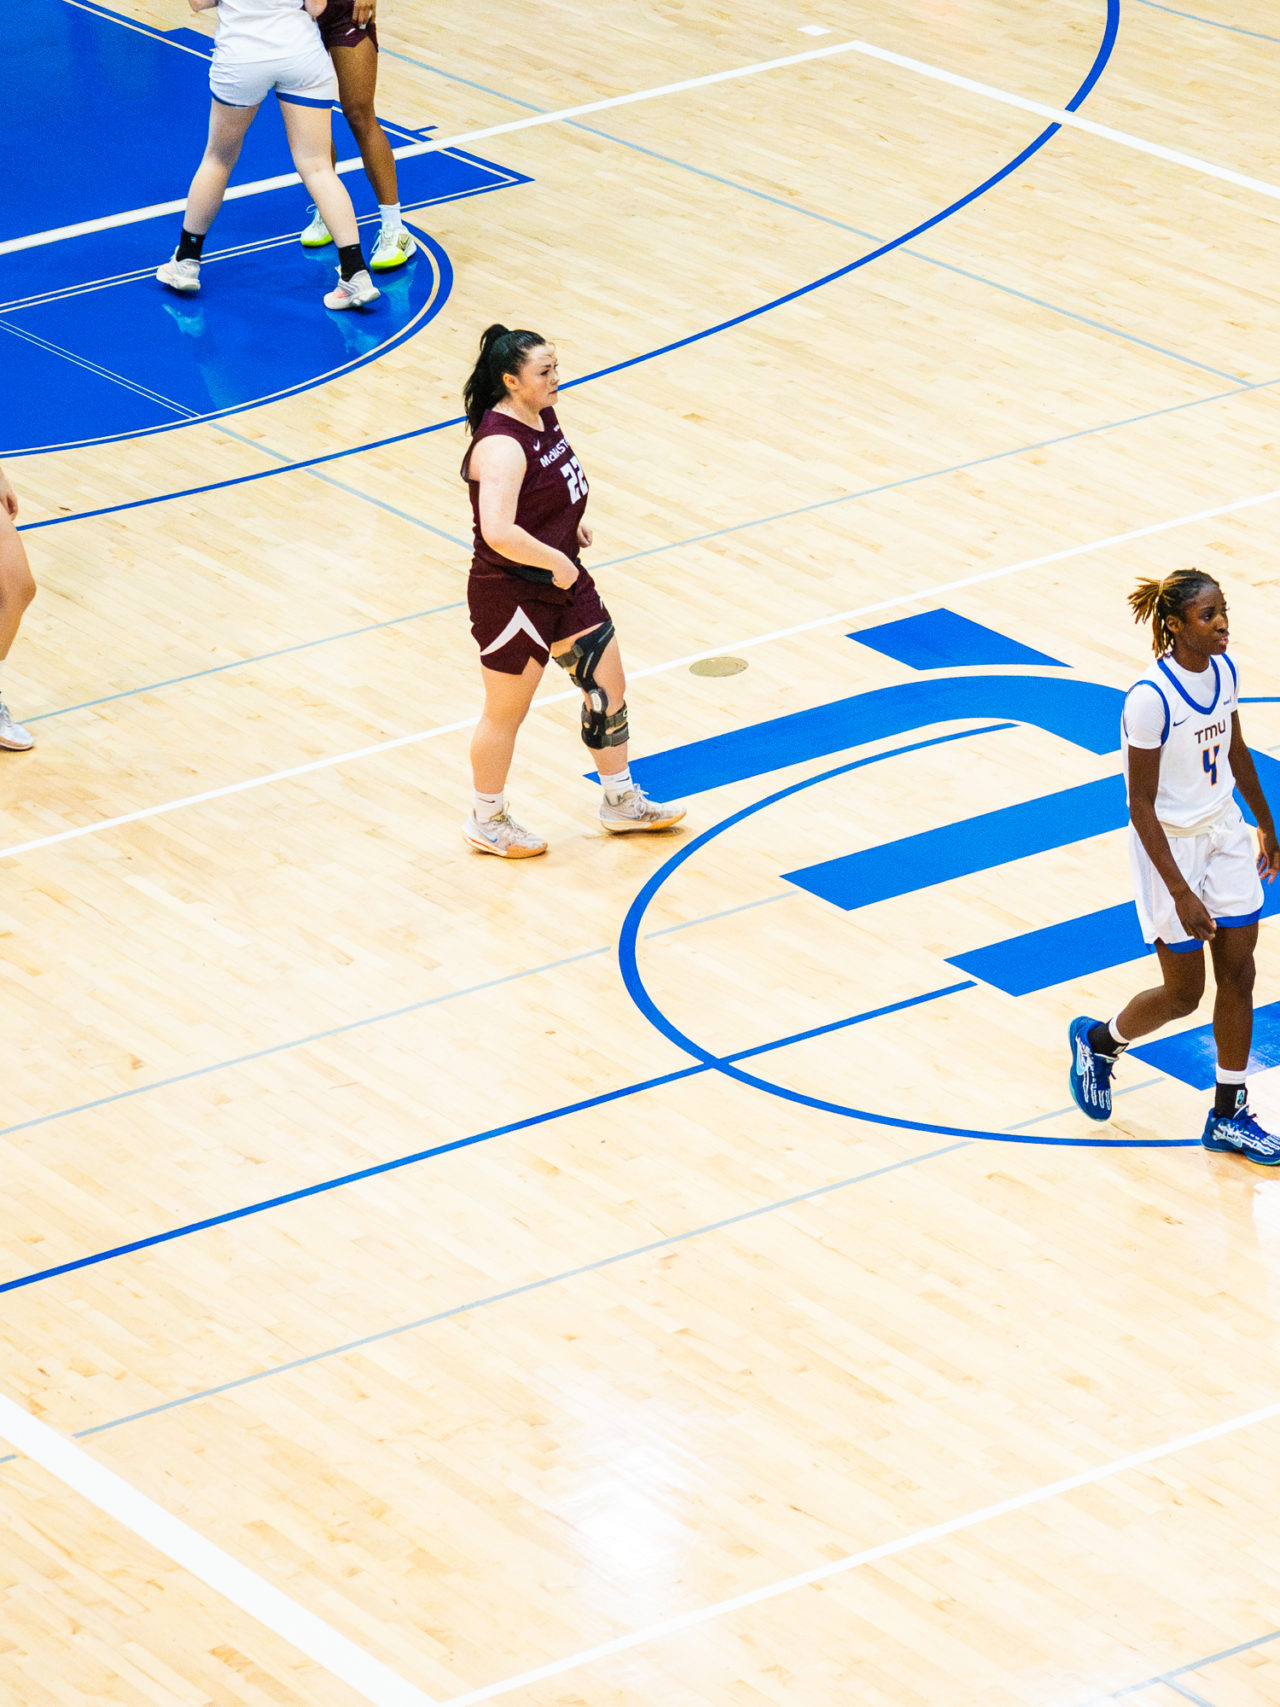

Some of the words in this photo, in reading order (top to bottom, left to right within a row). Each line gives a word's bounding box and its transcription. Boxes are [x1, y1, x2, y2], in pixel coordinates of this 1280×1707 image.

[560, 455, 589, 505] 22
[1194, 719, 1226, 744] TMU
[1202, 744, 1220, 787] 4
